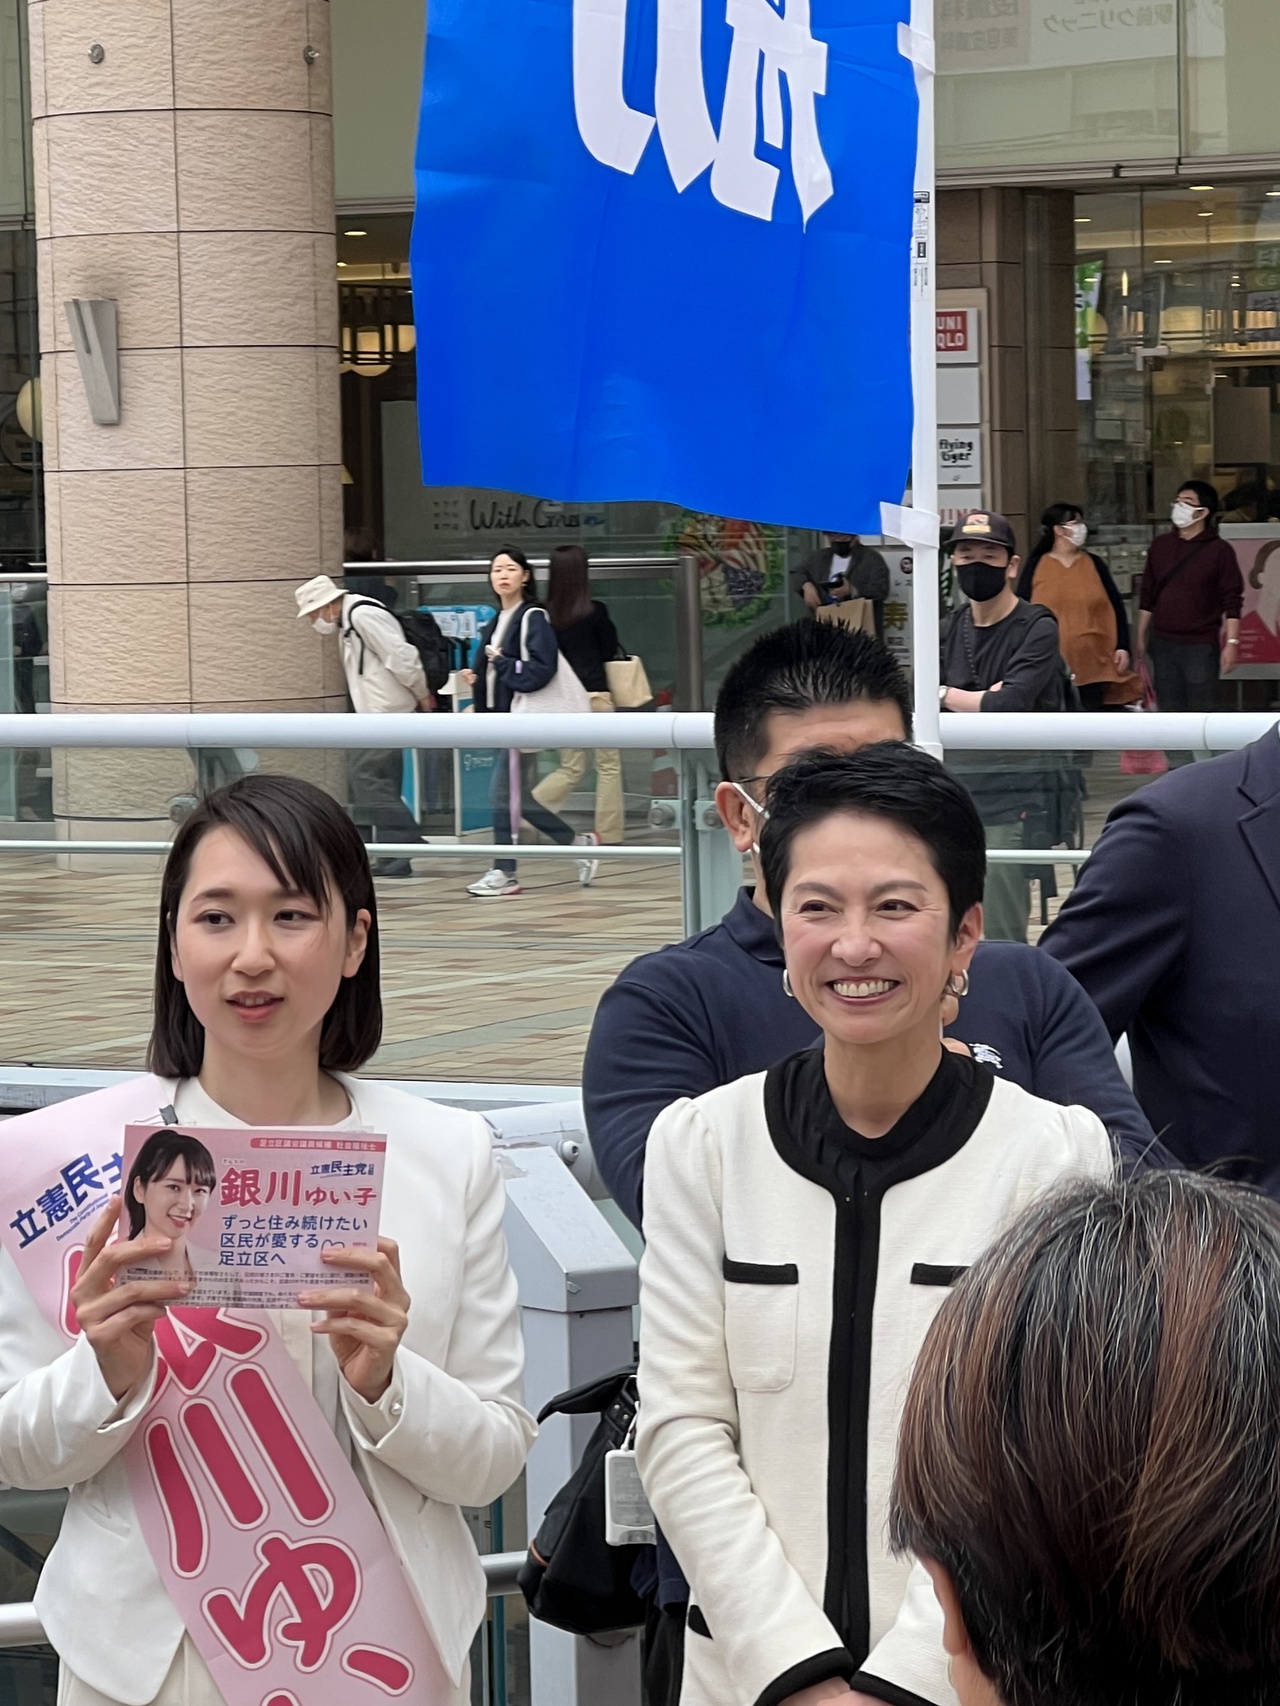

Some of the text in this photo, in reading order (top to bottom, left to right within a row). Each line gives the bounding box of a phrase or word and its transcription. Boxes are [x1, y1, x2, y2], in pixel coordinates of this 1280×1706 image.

[937, 316, 963, 330] UNI
[937, 332, 965, 349] QLO
[470, 499, 530, 530] With
[310, 1160, 368, 1176] 立憲民主党
[222, 1214, 368, 1231] ずっと住み続けたい
[220, 1232, 320, 1249] 区民が愛する
[218, 1250, 286, 1266] 足立区へ
